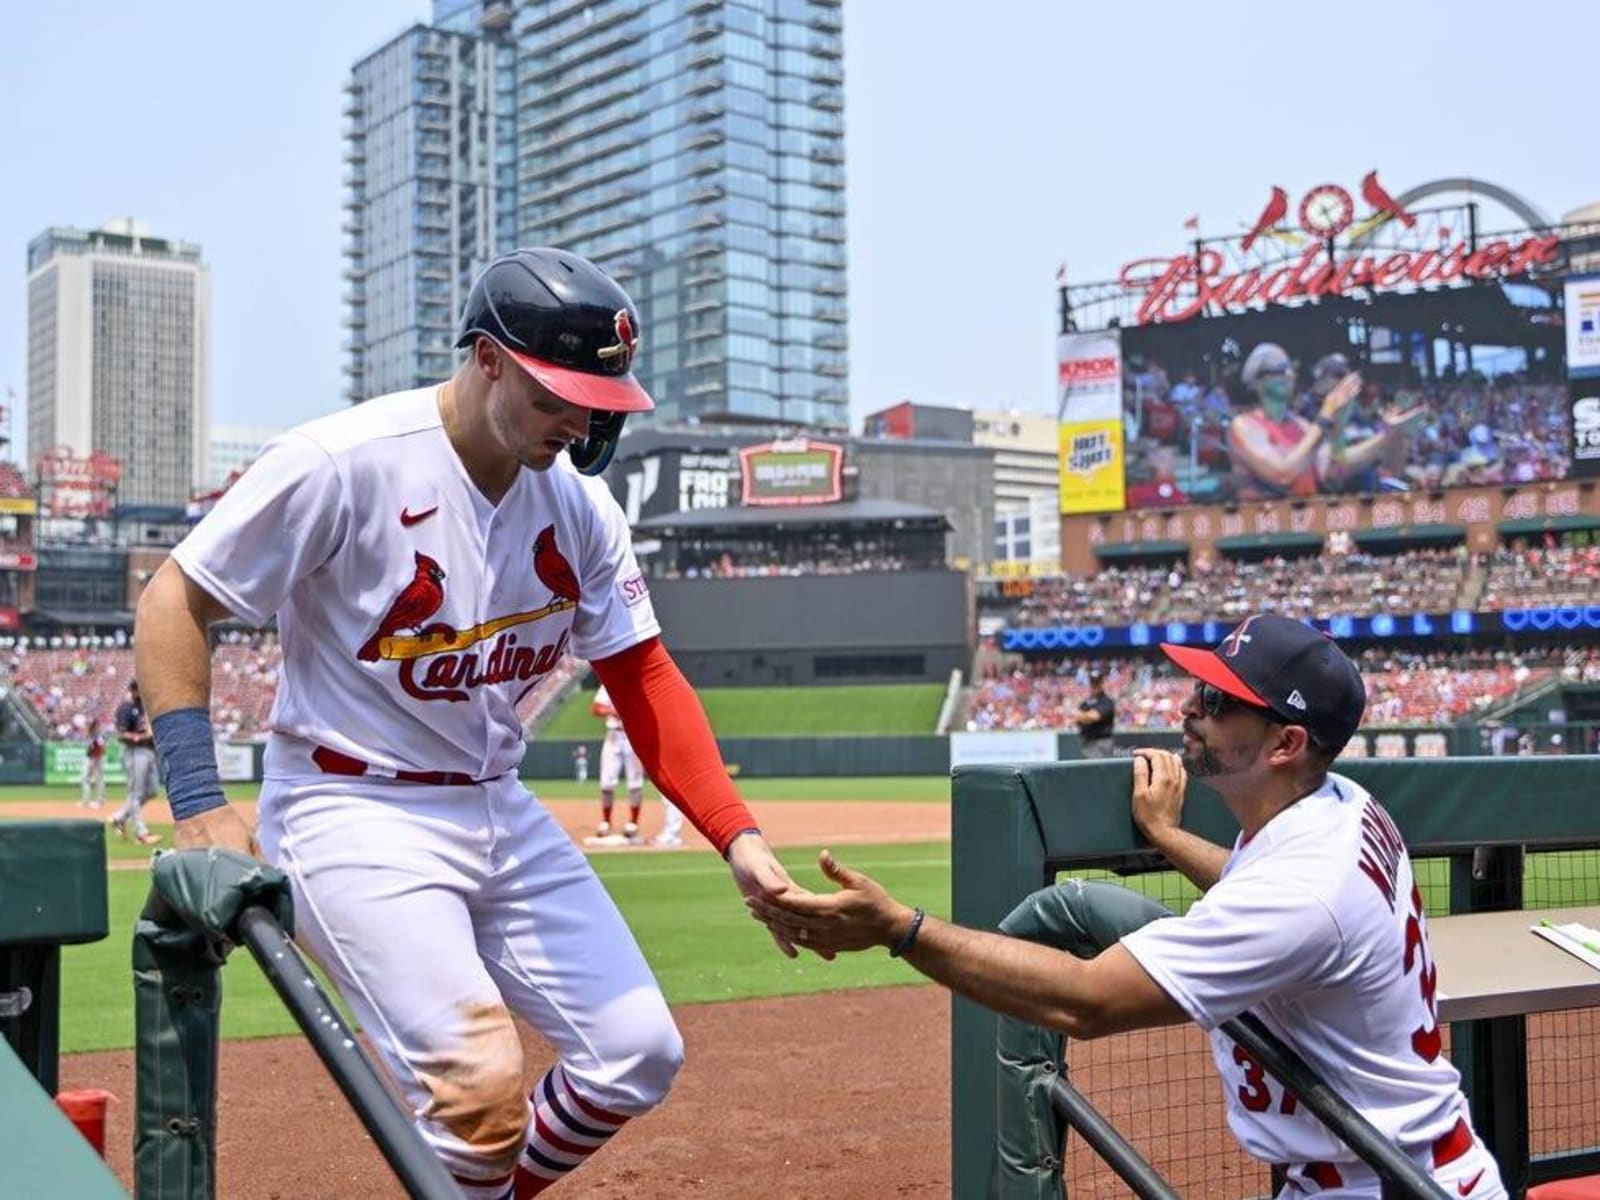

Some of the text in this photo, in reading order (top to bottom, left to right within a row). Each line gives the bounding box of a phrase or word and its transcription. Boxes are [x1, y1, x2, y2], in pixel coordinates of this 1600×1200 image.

[1121, 234, 1559, 325] Budweiser
[1456, 496, 1491, 522] 42
[398, 623, 571, 702] Cardinal
